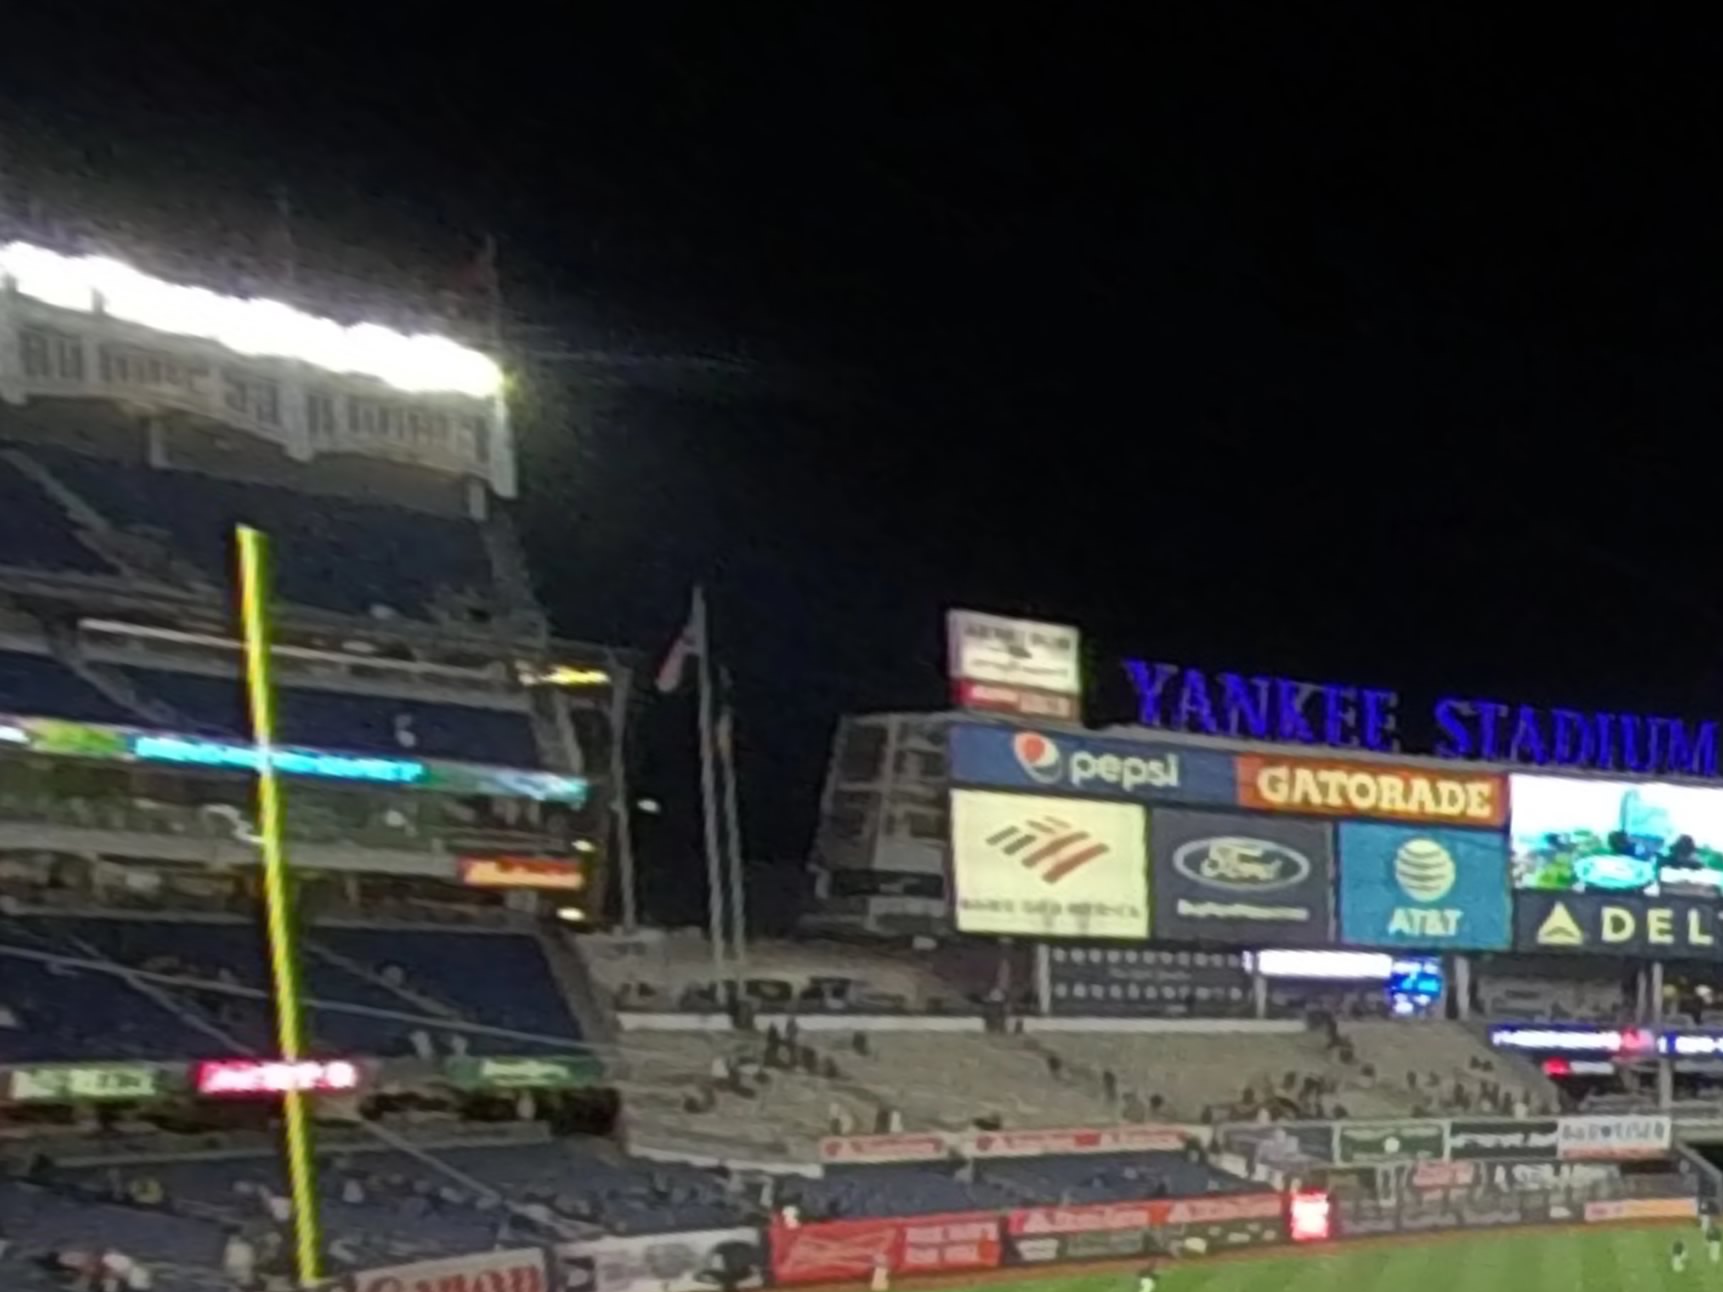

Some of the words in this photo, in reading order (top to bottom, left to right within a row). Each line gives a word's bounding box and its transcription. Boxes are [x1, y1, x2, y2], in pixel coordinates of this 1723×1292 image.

[1124, 660, 1398, 751] YANKEE
[1434, 698, 1719, 776] STADIUM
[1070, 748, 1179, 790] pepsi
[1257, 765, 1492, 817] GATORADE
[1198, 842, 1282, 881] Ford
[1387, 908, 1463, 936] AT&T
